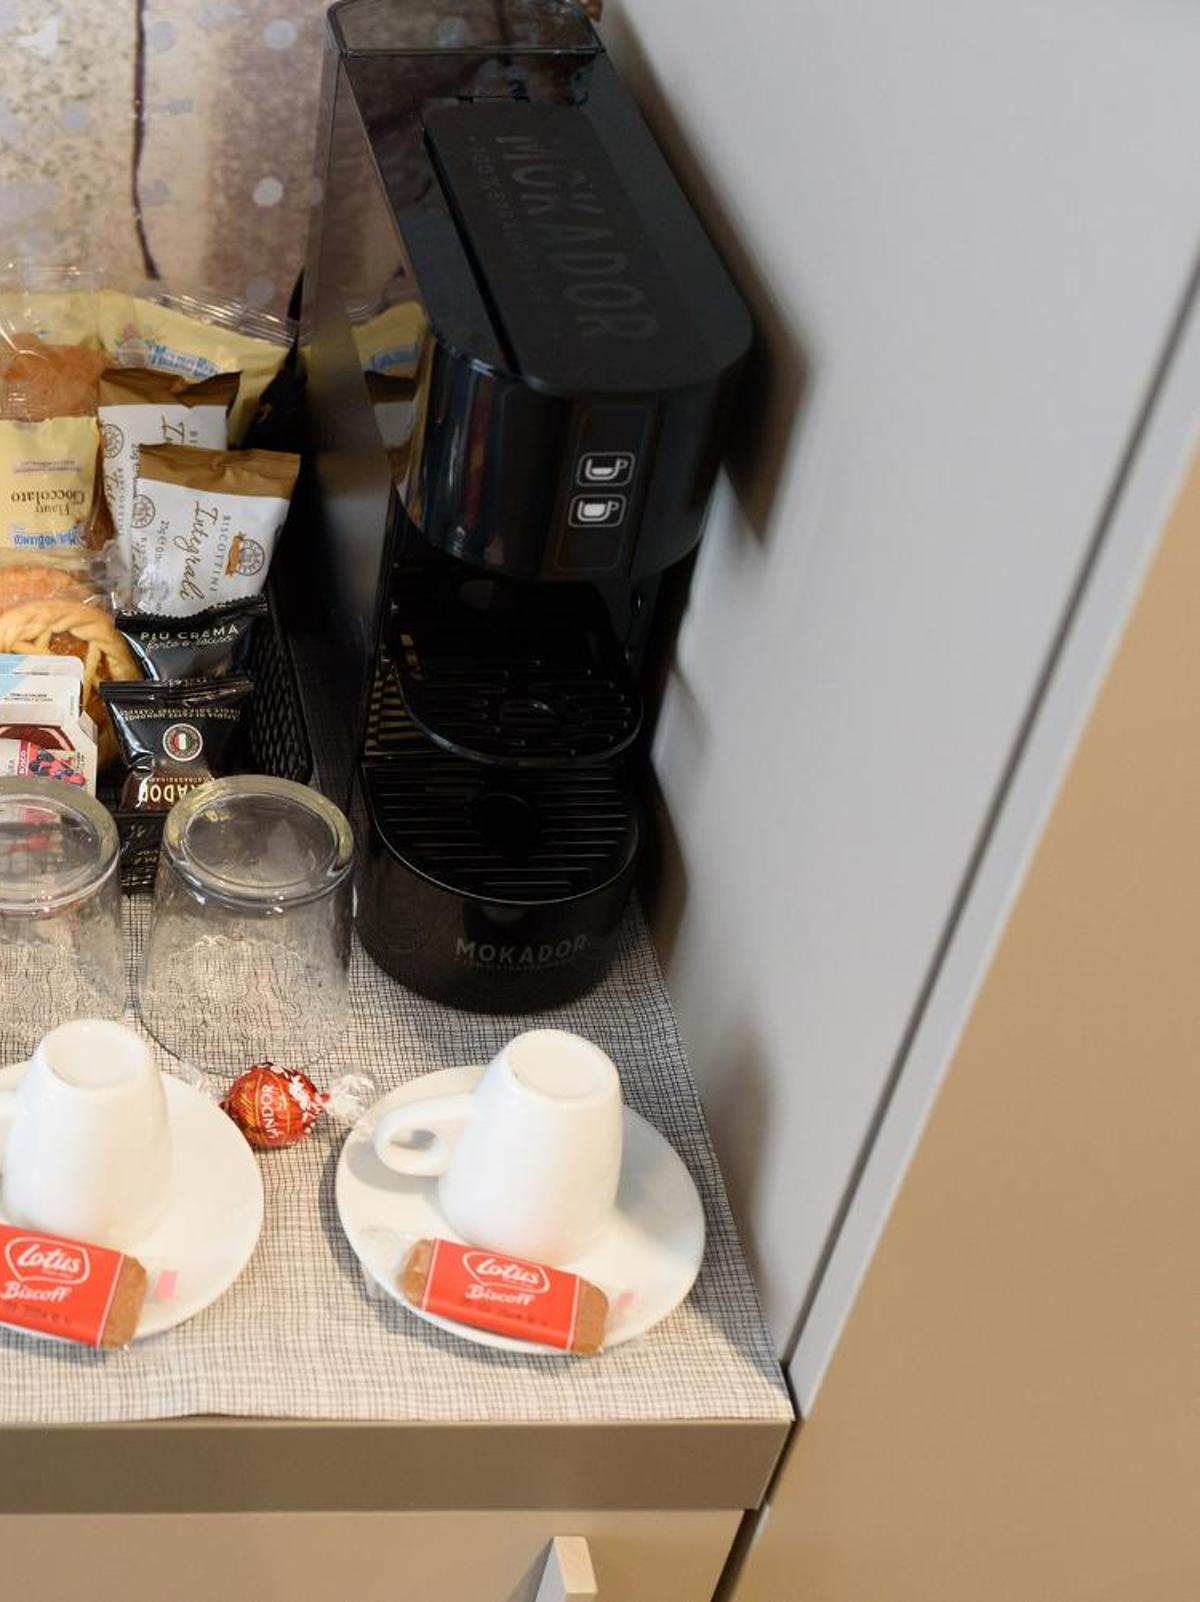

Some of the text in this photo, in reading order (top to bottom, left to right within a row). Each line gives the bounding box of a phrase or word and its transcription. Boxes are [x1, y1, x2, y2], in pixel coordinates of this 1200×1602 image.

[173, 500, 220, 600] Integrali
[208, 514, 231, 593] BISCOTTINI
[177, 623, 239, 640] CREMA
[455, 934, 587, 963] MOKADOR
[16, 1243, 82, 1274] Lotus
[475, 1257, 541, 1285] Lotus
[0, 1281, 72, 1303] Biscoff
[463, 1284, 535, 1306] Biscoff
